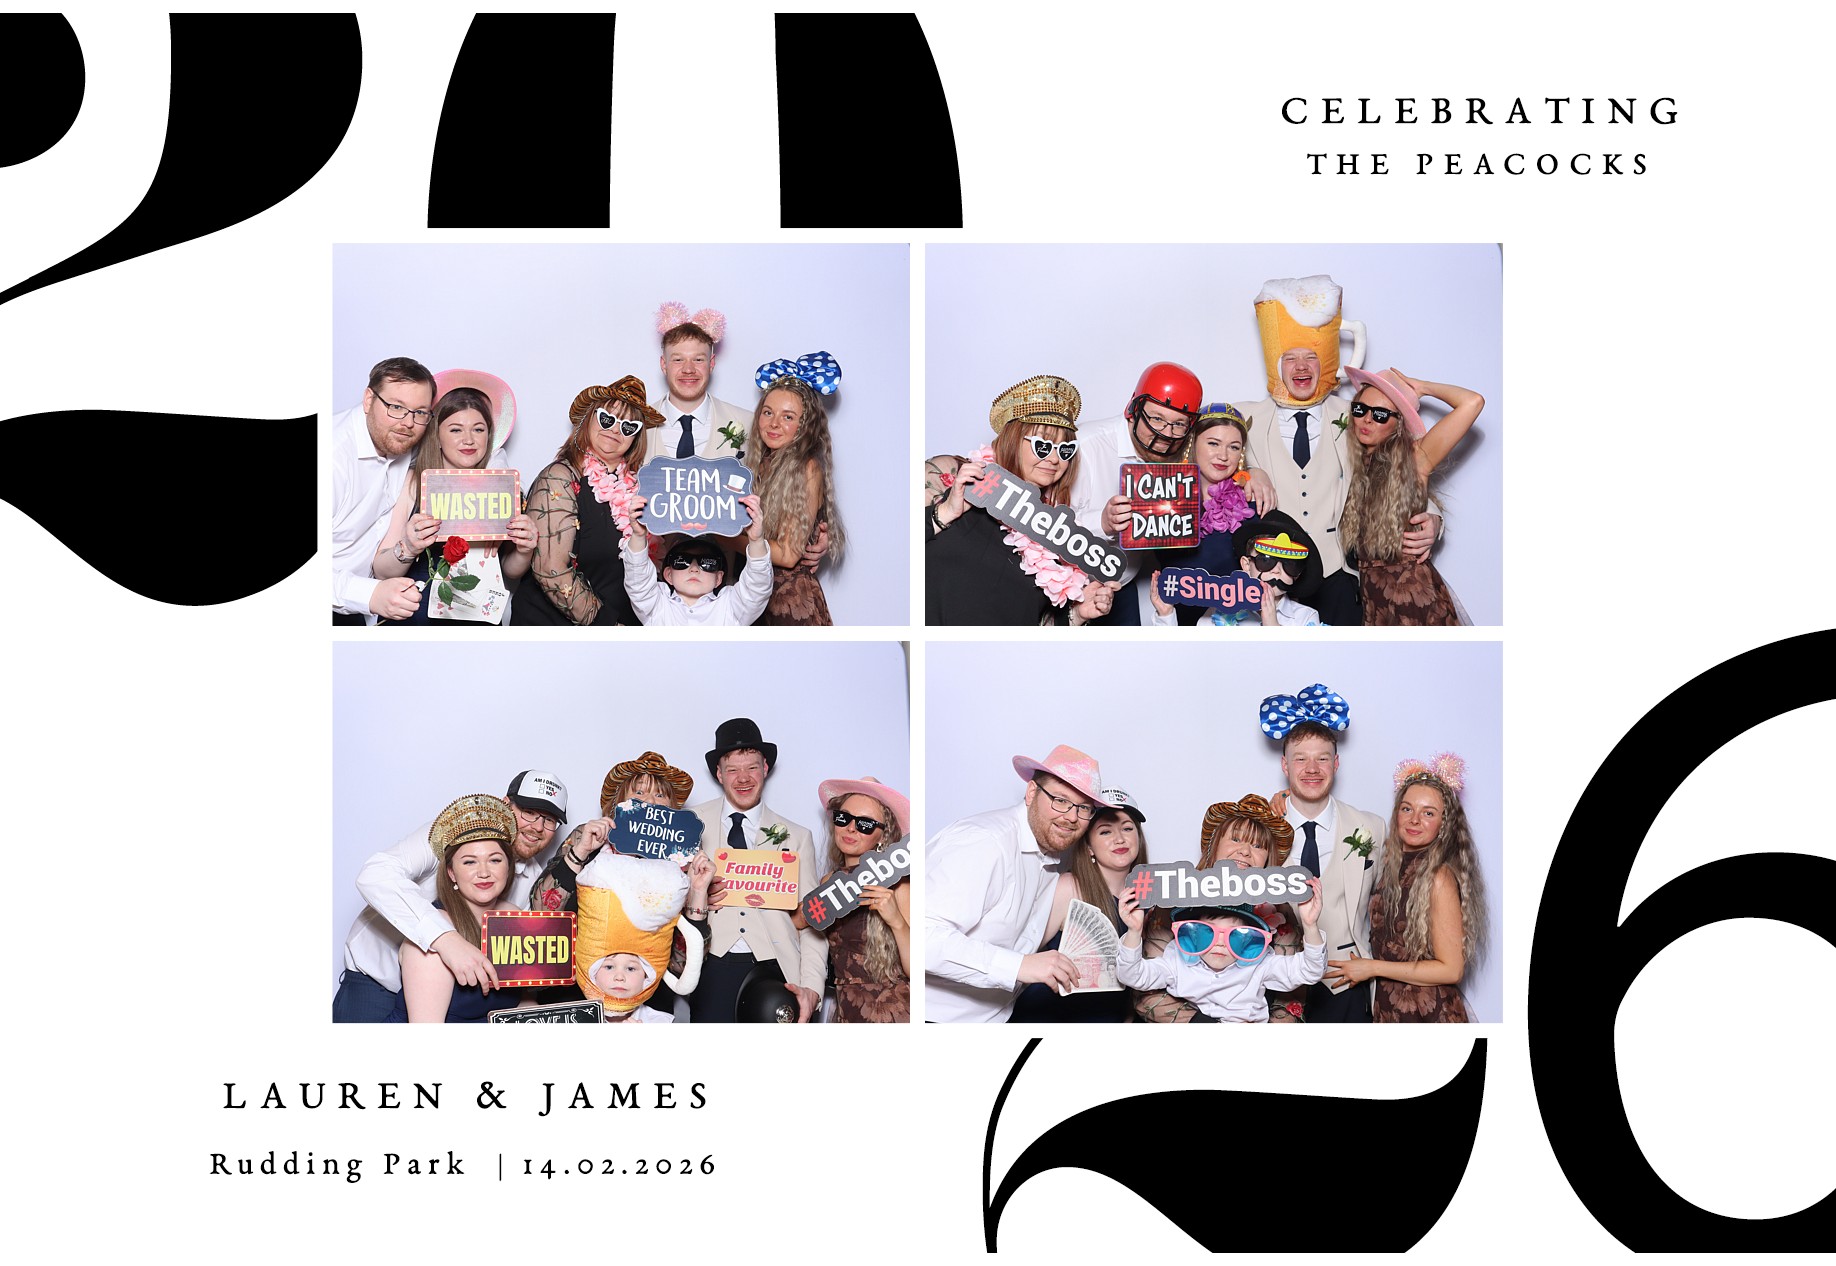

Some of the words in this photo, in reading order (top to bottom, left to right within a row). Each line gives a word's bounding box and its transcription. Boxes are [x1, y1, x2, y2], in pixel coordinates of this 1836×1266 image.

[660, 466, 721, 494] TEAM
[1125, 473, 1132, 498] I
[1137, 472, 1194, 499] CAN'T
[430, 492, 512, 521] WASTED
[650, 493, 736, 523] GROOM
[971, 470, 1121, 577] #Theboss
[1132, 512, 1193, 539] DANCE
[1163, 574, 1262, 608] #Single
[645, 807, 676, 825] BEST
[628, 820, 685, 843] WEDDING
[637, 839, 667, 859] EVER
[725, 862, 784, 879] Family
[807, 840, 910, 924] #Thebo
[1132, 866, 1308, 900] #Theboss
[722, 877, 798, 894] avourite
[490, 935, 569, 965] WASTED
